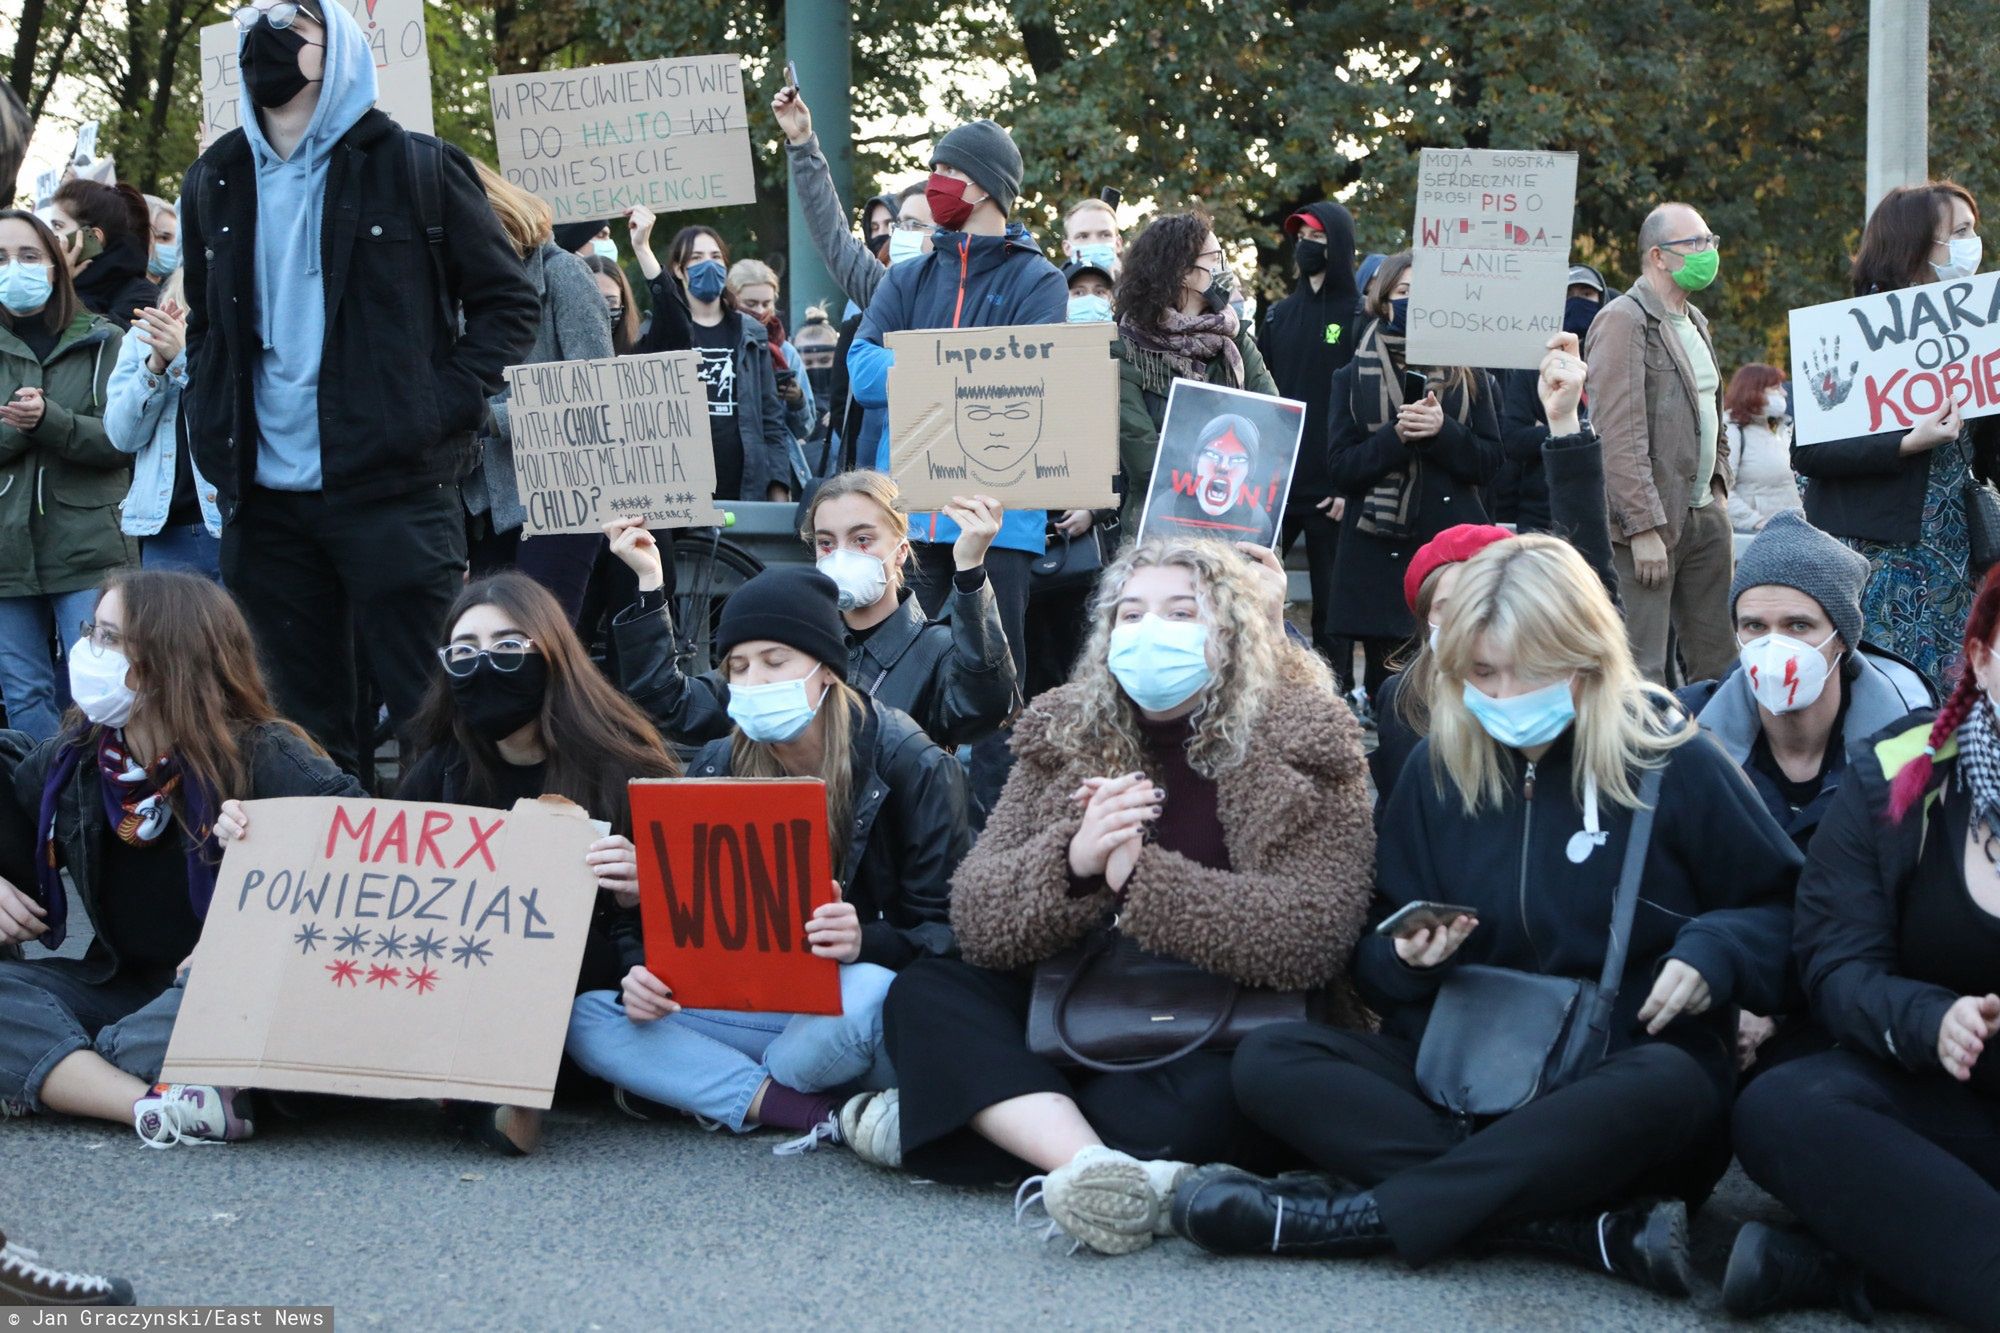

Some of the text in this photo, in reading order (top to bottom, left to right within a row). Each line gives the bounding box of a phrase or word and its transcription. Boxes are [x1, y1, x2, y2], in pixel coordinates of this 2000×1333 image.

[492, 64, 738, 120] W PRZECIWIEŃSTWIE
[520, 105, 731, 160] DO HAJTO WY
[1424, 173, 1538, 188] SERDECZNIE
[1426, 153, 1555, 173] MOJA SIOSTRA
[556, 174, 727, 218] NSEKWENCJE
[1424, 191, 1543, 212] PROSI PIS O
[1441, 253, 1521, 274] LANIE
[1466, 283, 1482, 301] W
[1412, 307, 1561, 332] PODSKOKACH
[936, 335, 1054, 374] Impostor
[1915, 333, 1970, 370] OD
[511, 367, 529, 406] IF
[515, 453, 548, 491] YOU
[672, 442, 686, 482] A
[529, 486, 601, 530] CHILD?
[325, 805, 505, 872] MARX
[238, 869, 554, 939] POWIEDZIAŁ
[650, 818, 813, 954] WON!
